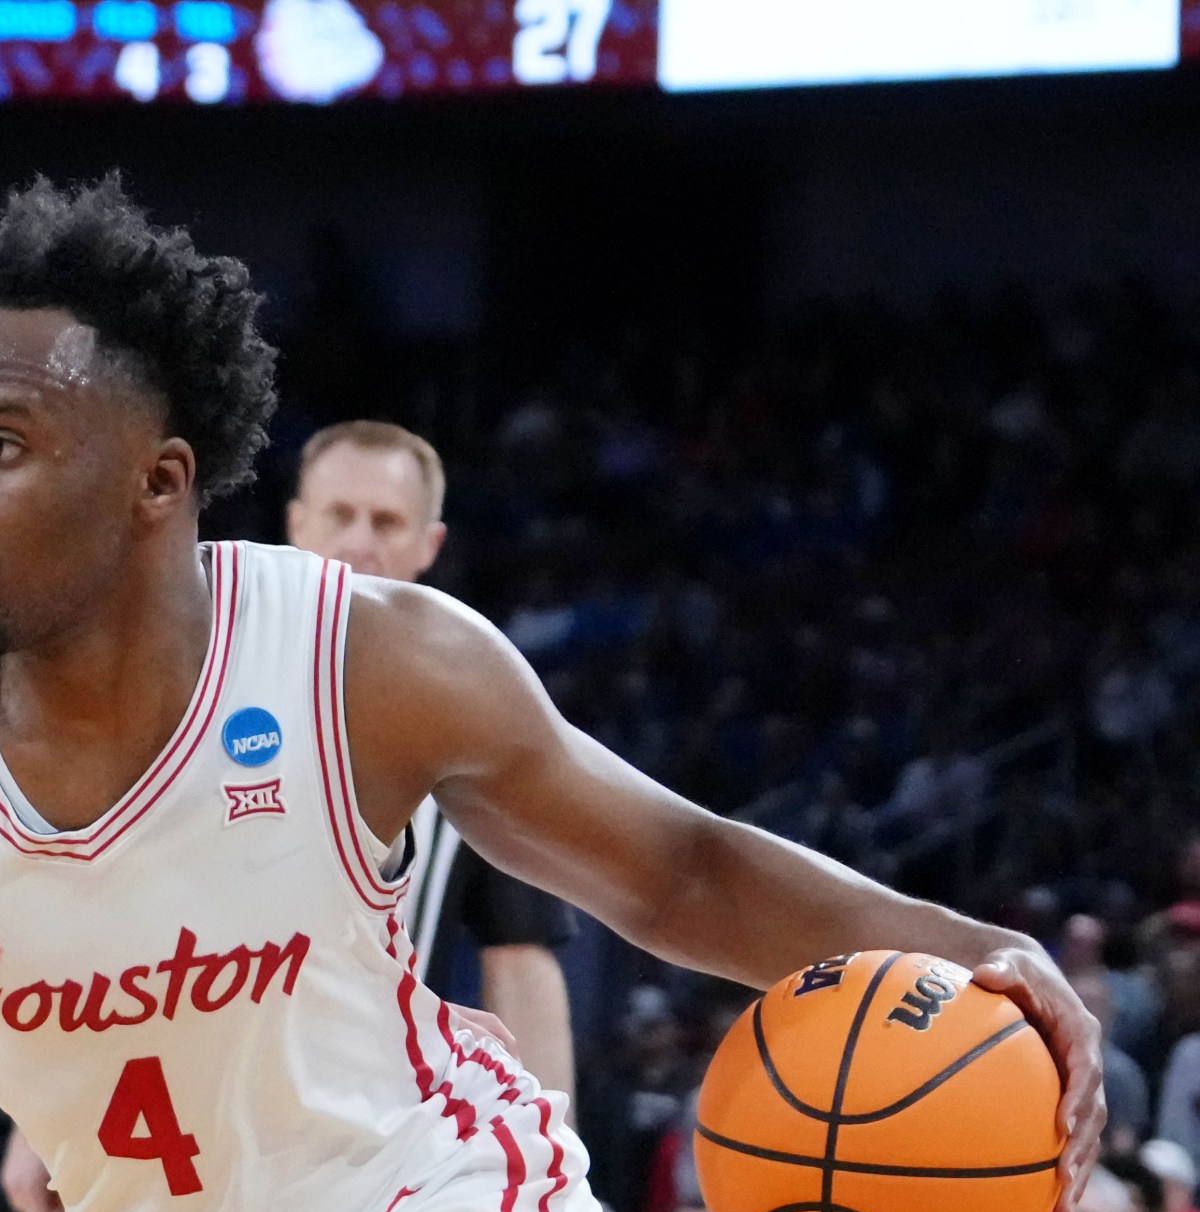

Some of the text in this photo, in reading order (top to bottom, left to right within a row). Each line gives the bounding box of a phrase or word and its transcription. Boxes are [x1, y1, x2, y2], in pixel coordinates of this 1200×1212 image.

[512, 0, 611, 85] 27
[232, 731, 281, 755] NCAA
[97, 1055, 203, 1197] 4
